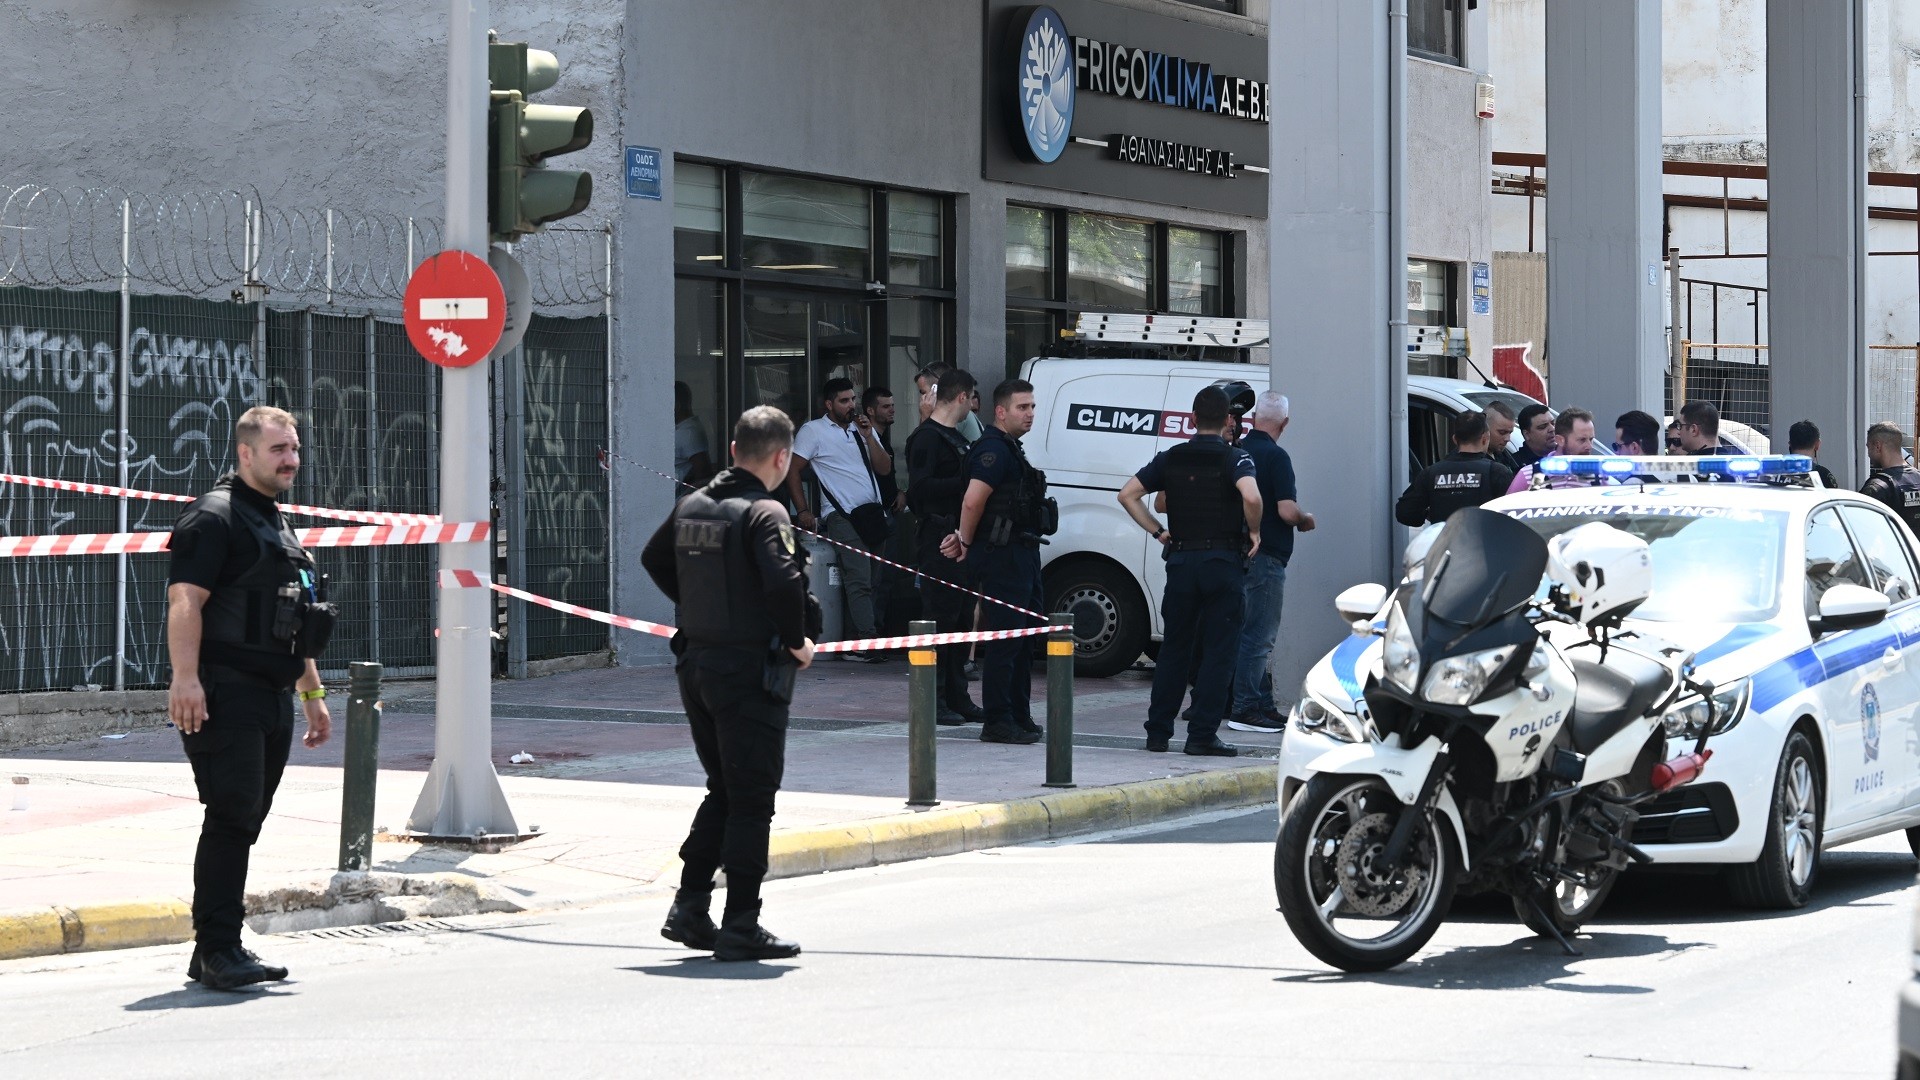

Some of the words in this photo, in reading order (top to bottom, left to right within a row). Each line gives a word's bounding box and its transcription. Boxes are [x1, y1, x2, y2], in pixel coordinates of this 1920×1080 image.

[1075, 37, 1217, 113] FRIGOKLIMA
[635, 153, 654, 166] ΟΔΟΣ
[1118, 135, 1212, 174] ΑΘΑΝΑΣΙΑΔΗΣ
[1216, 151, 1237, 178] Α.Ε.
[1077, 408, 1155, 432] CLIMA
[1436, 473, 1480, 485] ΔΙ.ΑΣ.
[1508, 710, 1562, 741] POLICE
[1854, 770, 1884, 795] POLICE
